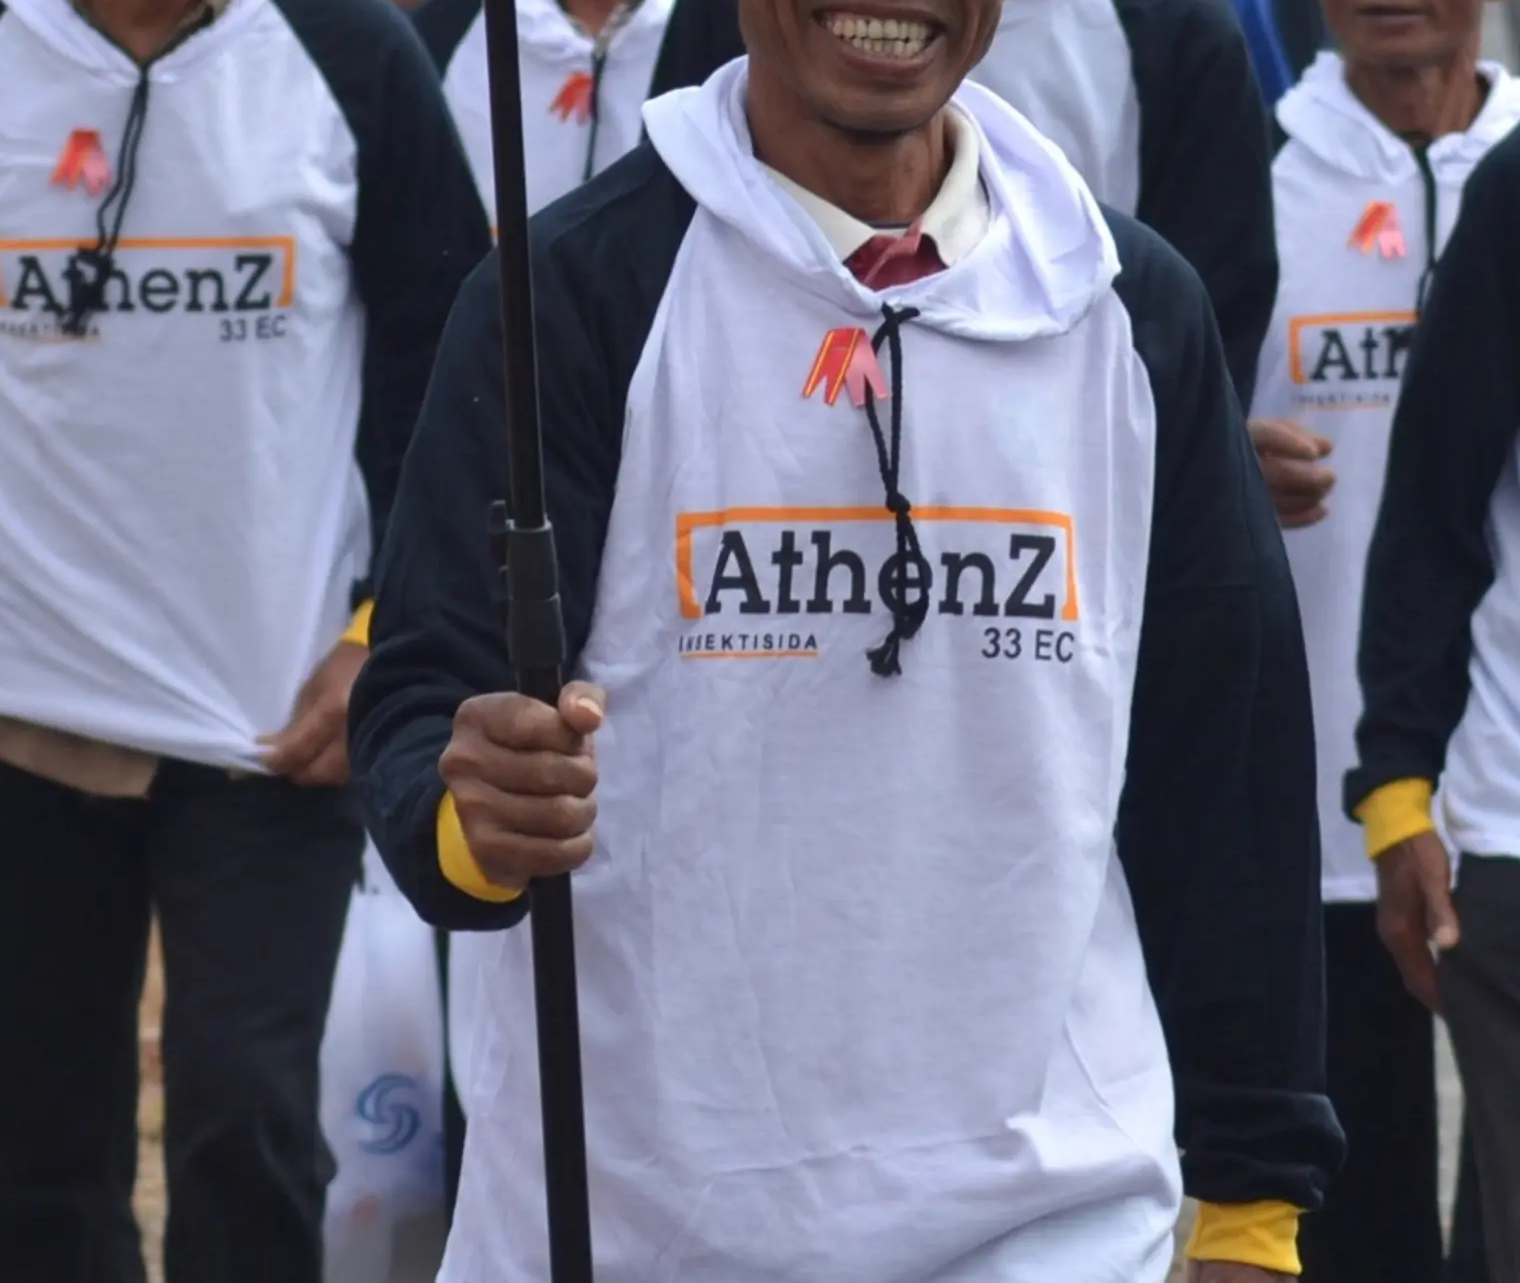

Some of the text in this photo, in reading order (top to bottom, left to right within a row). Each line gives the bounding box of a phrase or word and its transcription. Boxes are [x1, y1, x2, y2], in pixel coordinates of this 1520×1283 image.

[255, 316, 286, 339] EC
[705, 530, 1057, 620] AthenZ
[981, 628, 1076, 662] 33 EC
